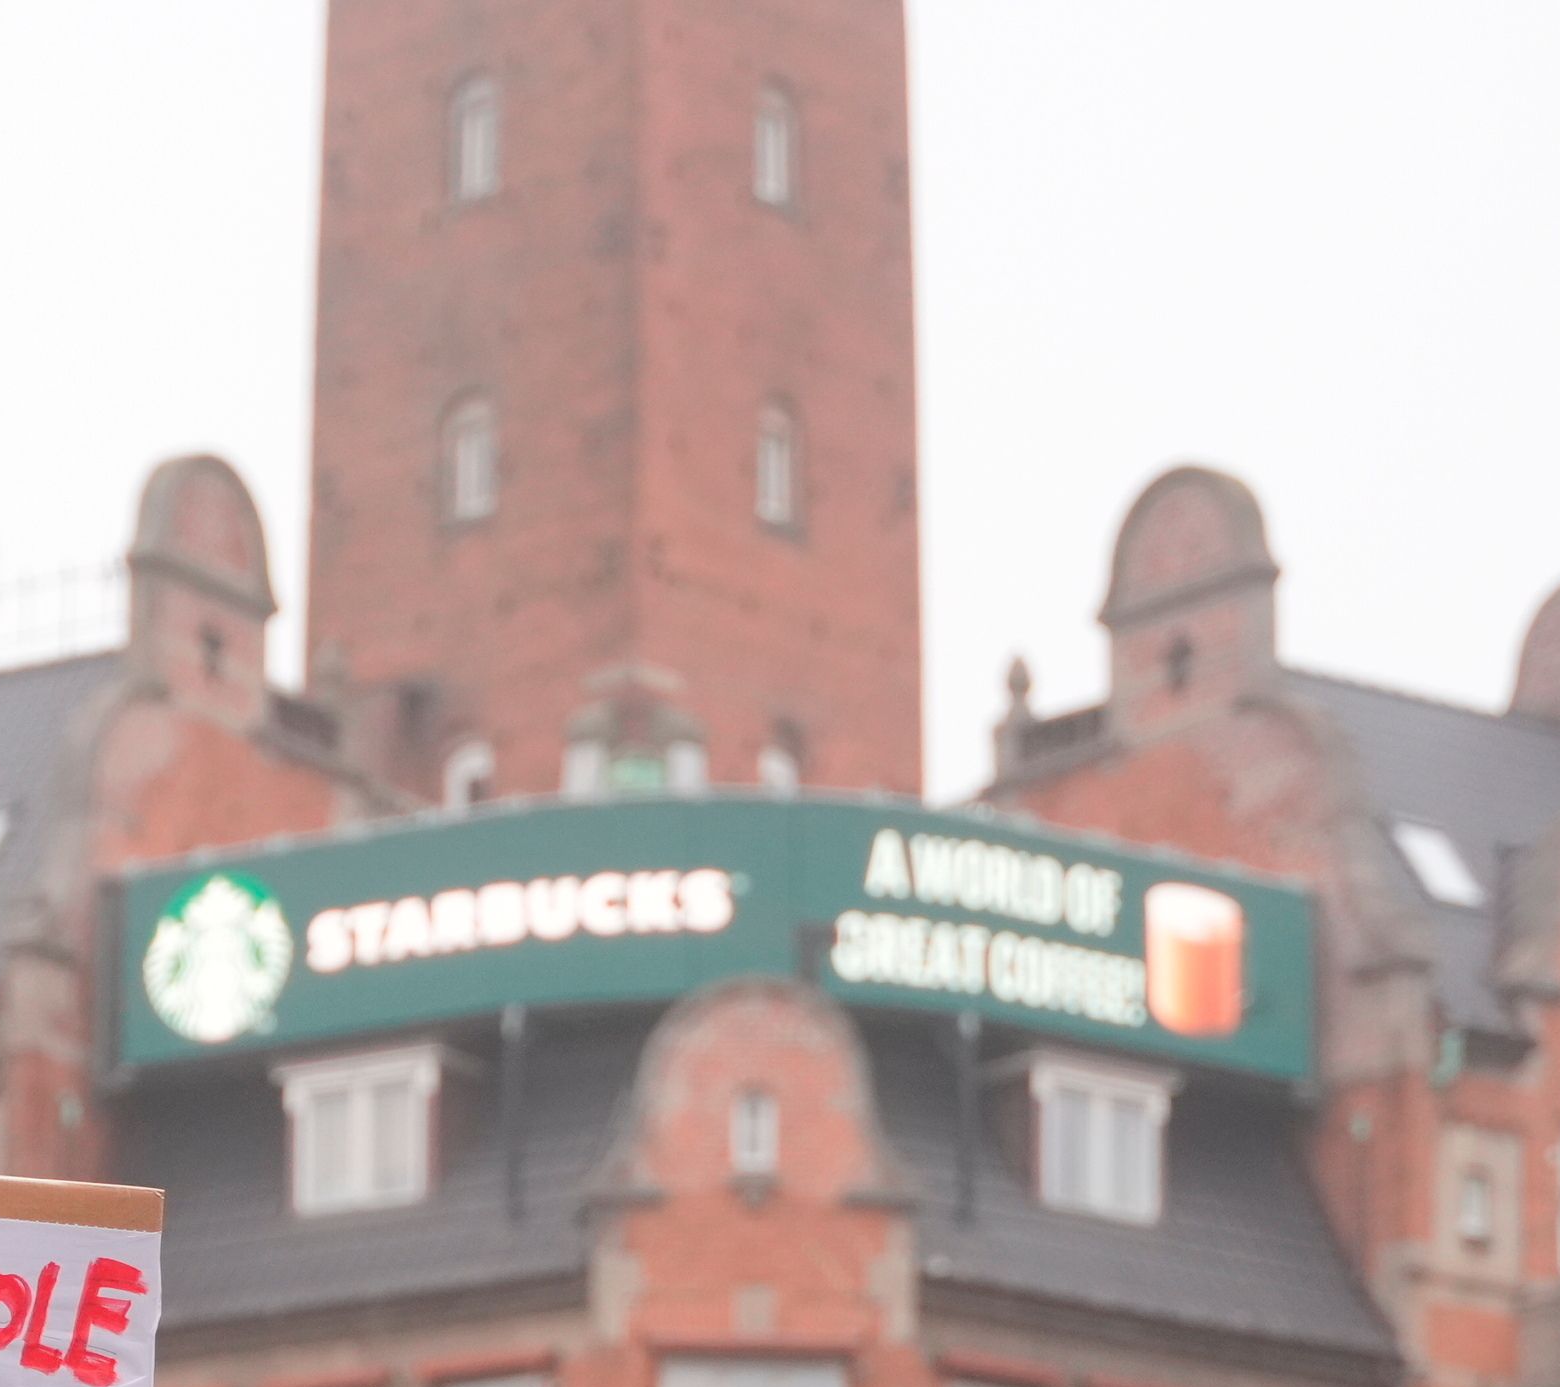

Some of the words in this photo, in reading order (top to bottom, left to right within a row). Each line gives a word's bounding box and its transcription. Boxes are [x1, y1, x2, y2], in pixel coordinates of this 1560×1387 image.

[306, 867, 735, 974] STARBUCKS
[864, 828, 912, 900] A
[909, 833, 1065, 926] WORLD
[1064, 862, 1123, 938] OF
[831, 909, 992, 995] GREAT
